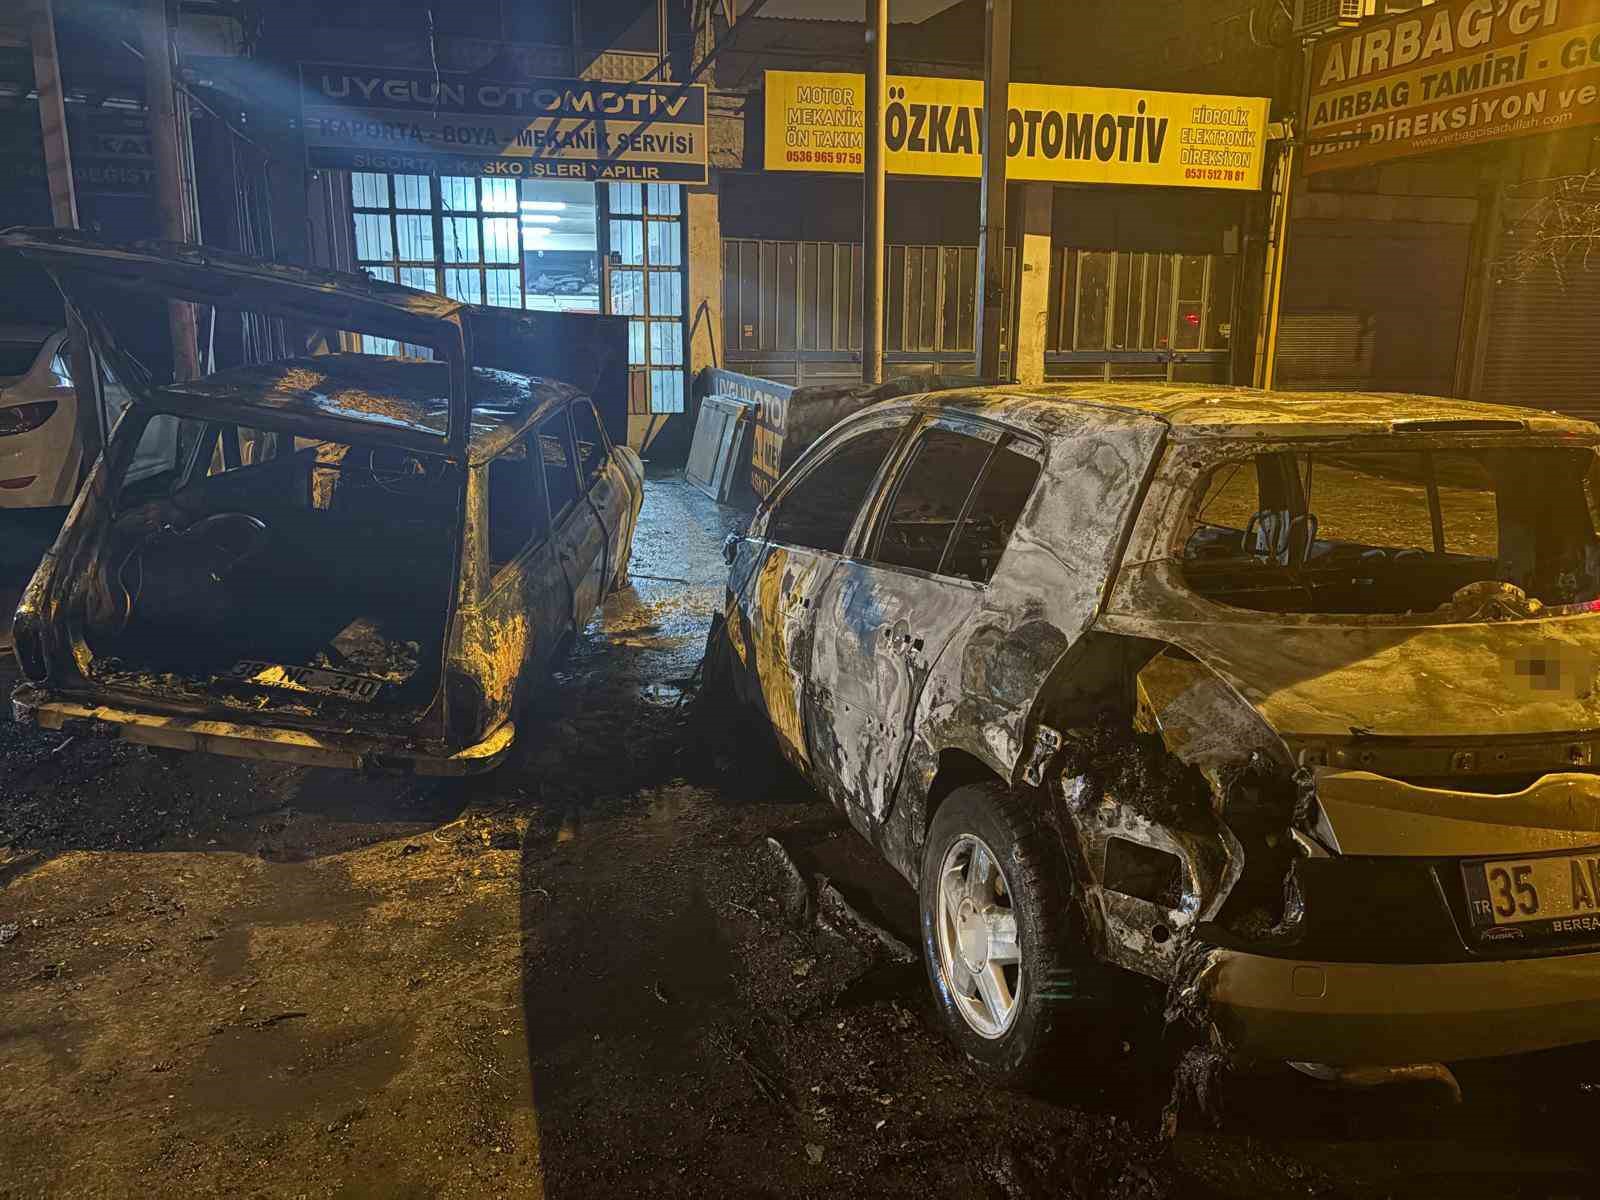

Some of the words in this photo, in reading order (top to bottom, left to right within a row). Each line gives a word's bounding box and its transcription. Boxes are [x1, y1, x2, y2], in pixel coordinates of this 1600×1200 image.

[1313, 81, 1411, 126] AIRBAG
[1420, 41, 1529, 100] TAMİRİ
[321, 74, 464, 105] UYGUN
[478, 85, 688, 117] OTOMOTİV
[797, 86, 854, 105] MOTOR
[787, 106, 864, 128] MEKANİK
[1192, 105, 1249, 126] HİDROLİK
[1368, 87, 1548, 144] DİREKSİYON
[1559, 84, 1598, 109] ve
[319, 119, 425, 142] KAPORTA
[443, 126, 497, 145] BOYA
[516, 128, 610, 151] MEKANİK
[618, 132, 694, 154] SERVİSİ
[786, 126, 810, 147] ÖN
[1006, 99, 1168, 164] OTOMOTİV
[1180, 127, 1256, 148] ELEKTRONİK
[352, 151, 438, 170] SİGORTA
[457, 160, 522, 175] KASKO
[786, 151, 812, 162] 0536
[814, 152, 834, 163] 965
[1180, 145, 1251, 168] DİREKSİYON
[1489, 864, 1540, 917] 35
[1472, 900, 1491, 914] TR
